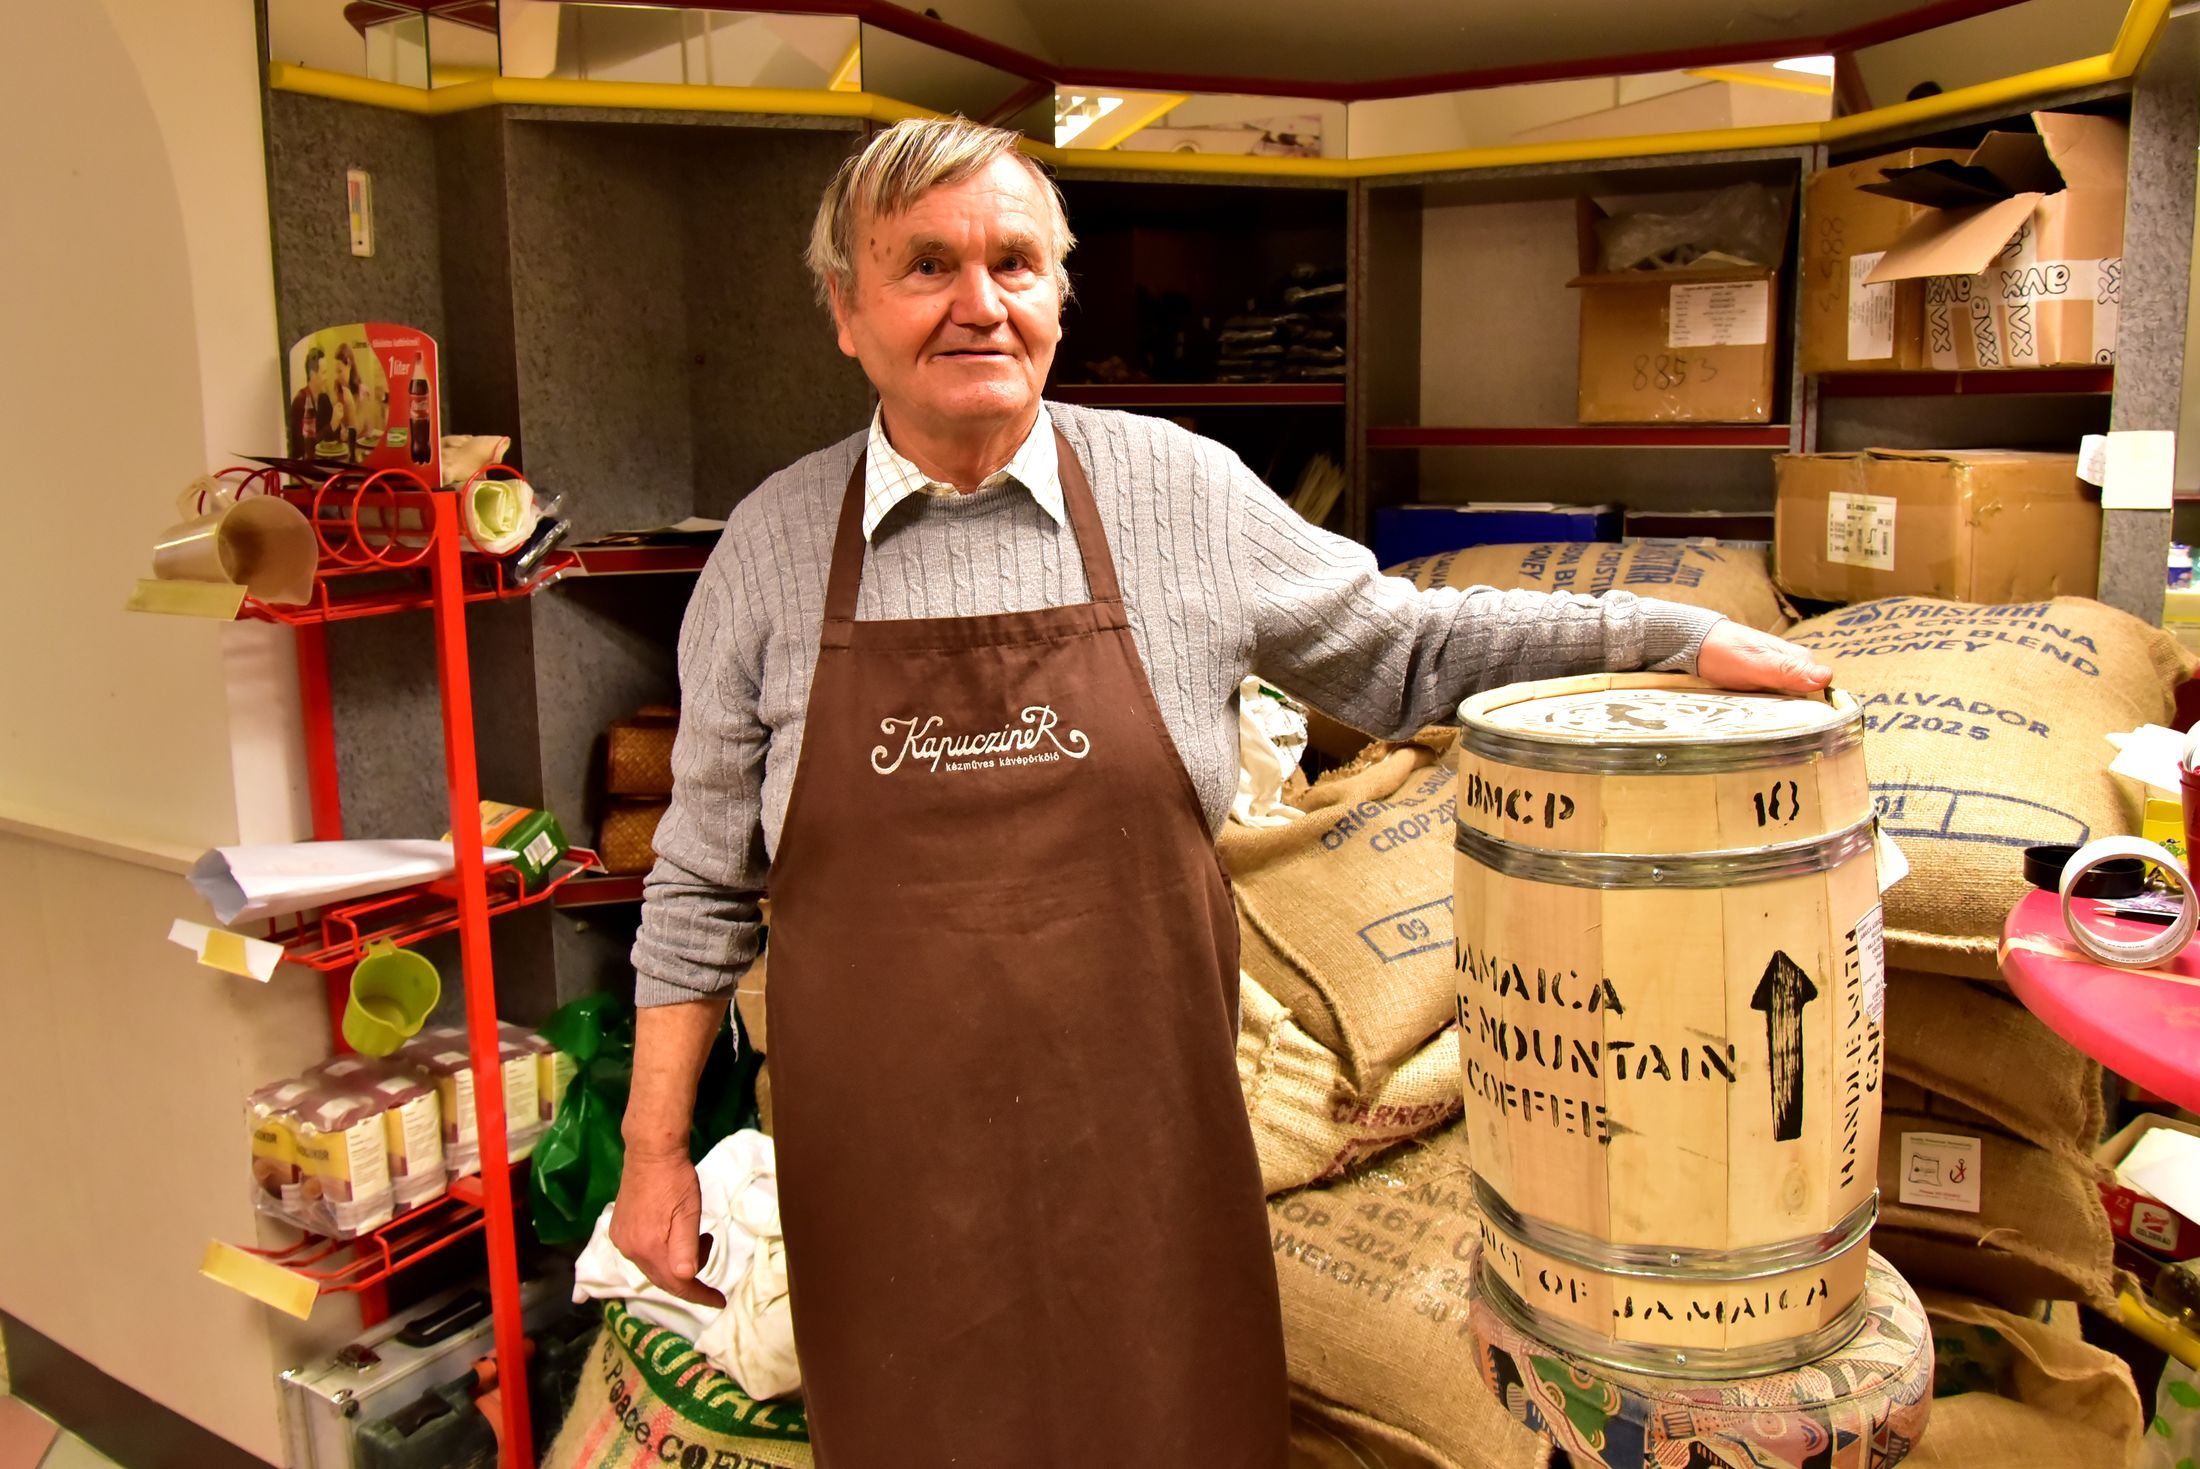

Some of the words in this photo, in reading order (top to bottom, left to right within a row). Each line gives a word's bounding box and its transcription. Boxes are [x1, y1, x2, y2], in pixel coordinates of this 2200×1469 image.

[1835, 639, 1991, 659] HONEY
[1915, 618, 2098, 655] CRISTINA
[1968, 630, 2099, 676] BLEND
[1858, 692, 2050, 739] ALVADOR
[1467, 773, 1575, 829] BMCP
[1369, 813, 1431, 853] CROP
[1455, 937, 1625, 1015] JAMAICA
[1479, 1006, 1736, 1082] MOUNTAIN
[1467, 1058, 1612, 1145] COFFEE
[1272, 1229, 1400, 1302] WEIGHT
[1539, 1270, 1587, 1303] OF
[1612, 1278, 1828, 1324] JAMAICA
